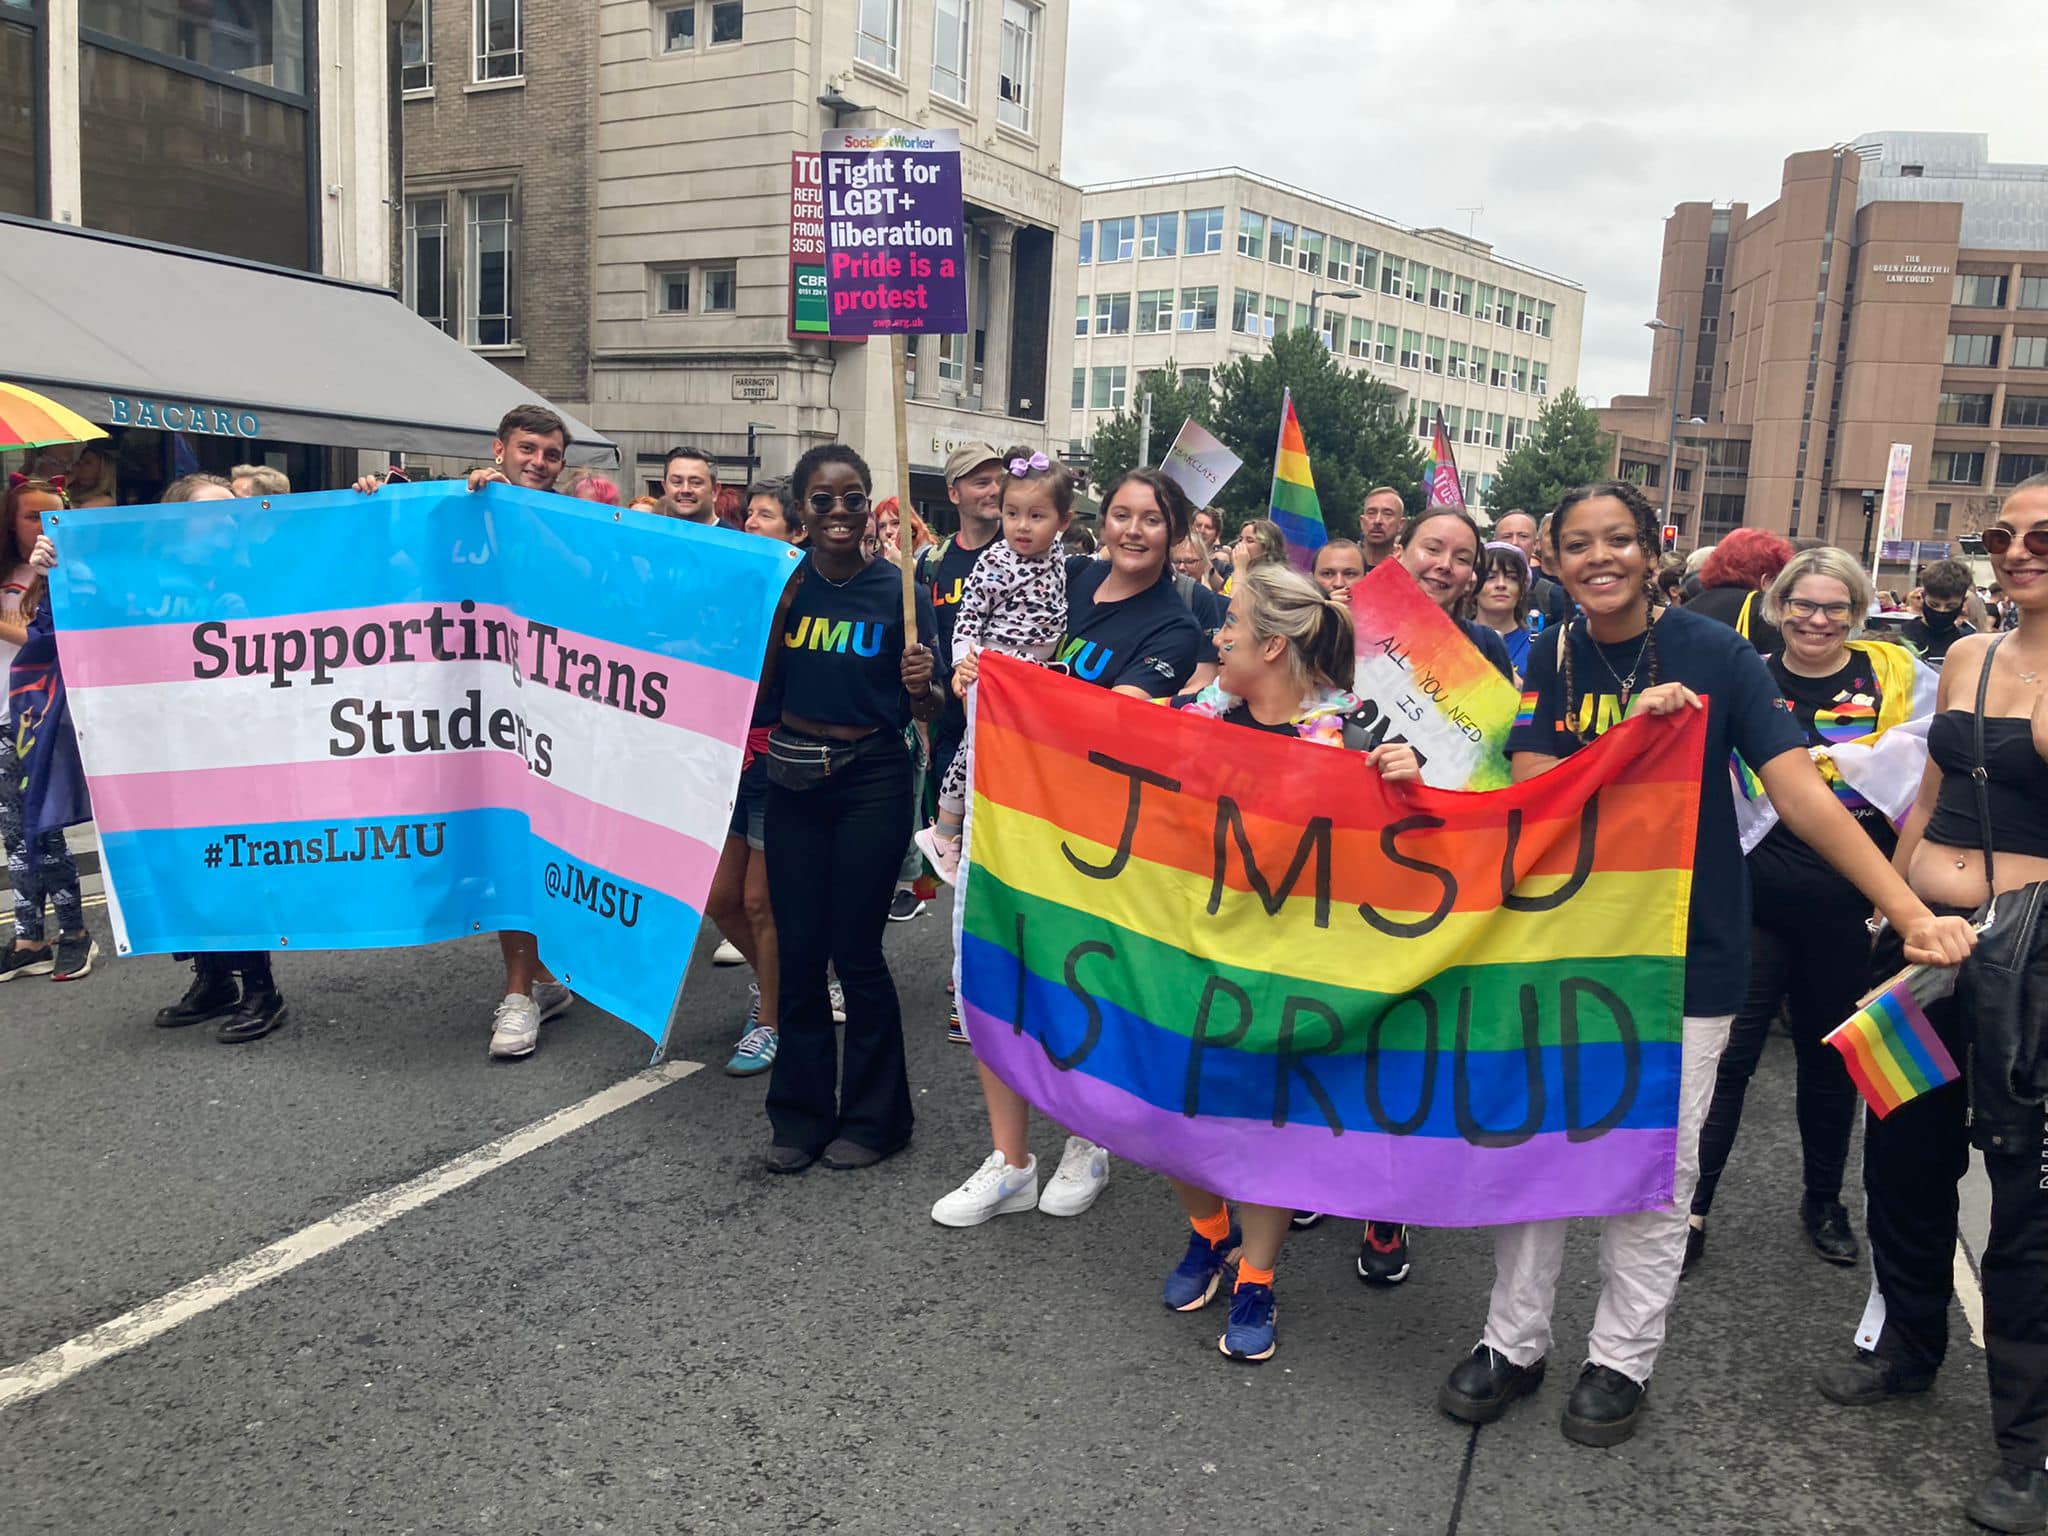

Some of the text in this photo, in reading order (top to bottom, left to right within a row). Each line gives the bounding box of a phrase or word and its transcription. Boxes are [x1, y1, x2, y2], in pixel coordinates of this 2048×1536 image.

[828, 158, 895, 189] Fight
[902, 157, 941, 184] for
[794, 187, 823, 202] REFU
[829, 188, 915, 216] LGBT+
[793, 204, 824, 219] OFFIC
[793, 222, 824, 237] FROM
[830, 220, 953, 247] liberation
[792, 239, 825, 253] 350 S
[1905, 255, 1920, 263] THE
[832, 251, 955, 278] Pride is a
[1886, 274, 1935, 283] LAW COURTS
[798, 275, 827, 287] CBR
[834, 284, 928, 316] protest
[735, 377, 775, 386] HARRINGTON
[743, 387, 766, 397] STREET
[109, 395, 261, 439] BACARO
[933, 577, 962, 607] LJ
[192, 599, 669, 719] Supporting Trans
[1375, 636, 1483, 743] ALL YOU NEED
[1396, 694, 1424, 722] IS
[203, 822, 447, 868] #TransLJMU
[1059, 750, 1601, 938] JMSU
[544, 862, 643, 928] @JMSU
[1013, 913, 1642, 1149] IS PROUD
